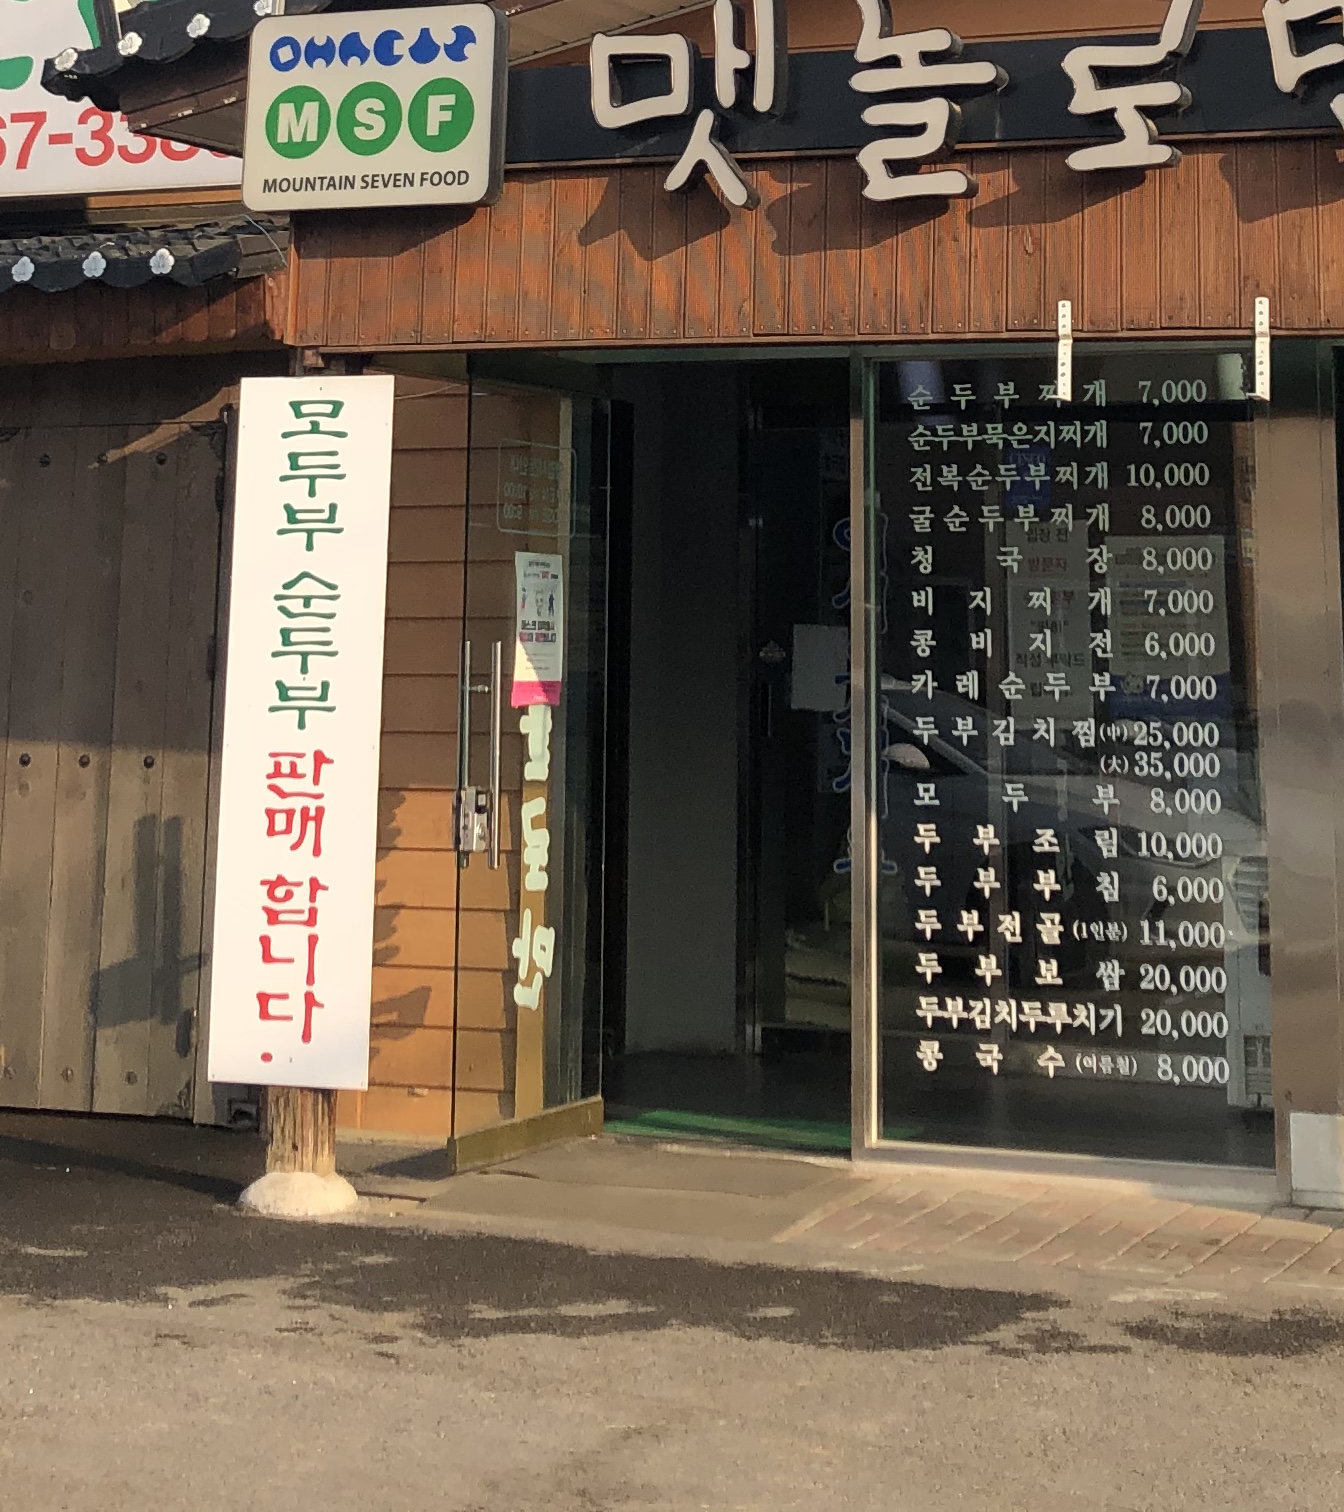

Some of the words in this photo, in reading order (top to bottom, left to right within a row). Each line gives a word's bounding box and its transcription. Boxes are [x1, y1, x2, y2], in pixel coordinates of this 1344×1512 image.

[262, 175, 356, 194] MOUNTAIN
[360, 172, 415, 190] SEVEN
[419, 170, 470, 187] FOOD
[1138, 379, 1207, 407] 7,000
[1139, 421, 1209, 449] 7,000
[276, 400, 349, 552] 모두부
[909, 461, 1109, 492] 전복순두부찌개
[1126, 462, 1210, 490] 10,000
[1140, 504, 1212, 532] 8,000
[1142, 547, 1213, 574] 8,000
[1144, 589, 1214, 617] 7,000
[268, 570, 341, 730] 순두부
[1144, 631, 1216, 660] 6,000
[1146, 674, 1217, 703] 7,000
[1133, 721, 1220, 750] 25,000
[1133, 751, 1221, 781] 35,000
[264, 749, 335, 857] 판매
[1150, 788, 1222, 817] 8,000
[1137, 831, 1223, 861] 10,000
[1152, 876, 1224, 906] 6,000
[1139, 919, 1225, 951] 11,000
[1139, 963, 1227, 995] 20,000
[1140, 1008, 1229, 1039] 20,000
[1156, 1054, 1230, 1086] 8,000
